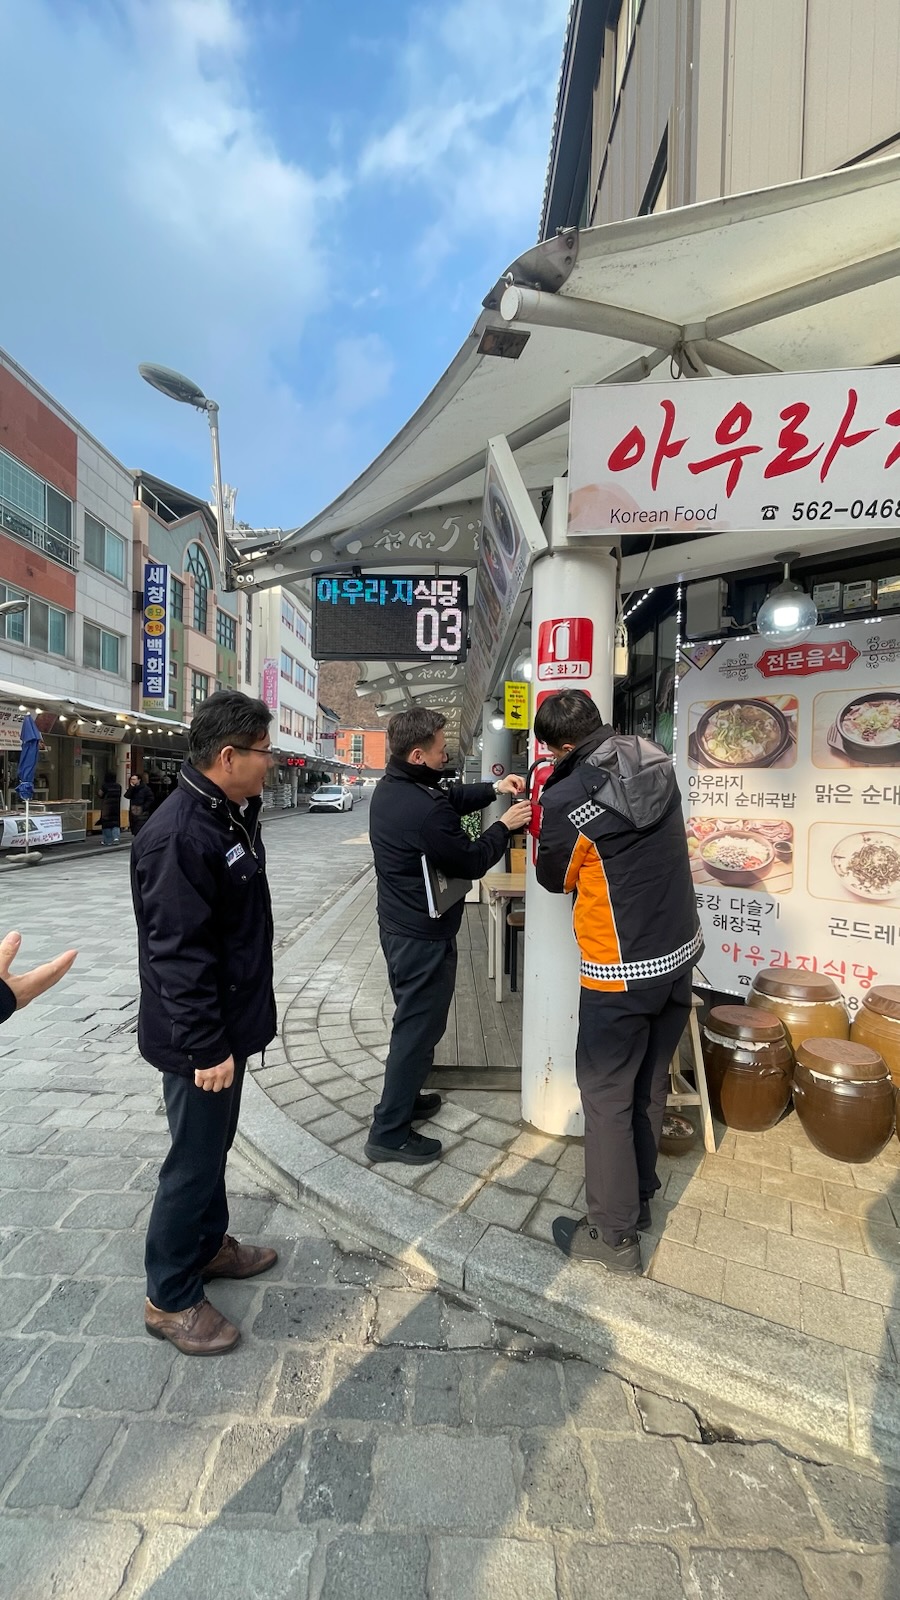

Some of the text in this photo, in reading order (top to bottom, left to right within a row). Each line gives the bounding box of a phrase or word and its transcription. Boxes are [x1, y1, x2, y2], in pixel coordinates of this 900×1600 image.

[610, 504, 718, 524] Korean Food
[147, 567, 165, 604] 세창
[416, 607, 462, 652] 03
[146, 638, 165, 694] 백화점
[544, 663, 582, 676] 소화기
[766, 645, 847, 673] 전문음식
[688, 774, 744, 790] 아우라지
[687, 791, 797, 809] 우거지 순대국밥
[815, 783, 900, 806] 맑은 순대
[730, 897, 780, 920] 다슬기
[712, 914, 763, 937] 해장국
[828, 916, 900, 946] 곤드레
